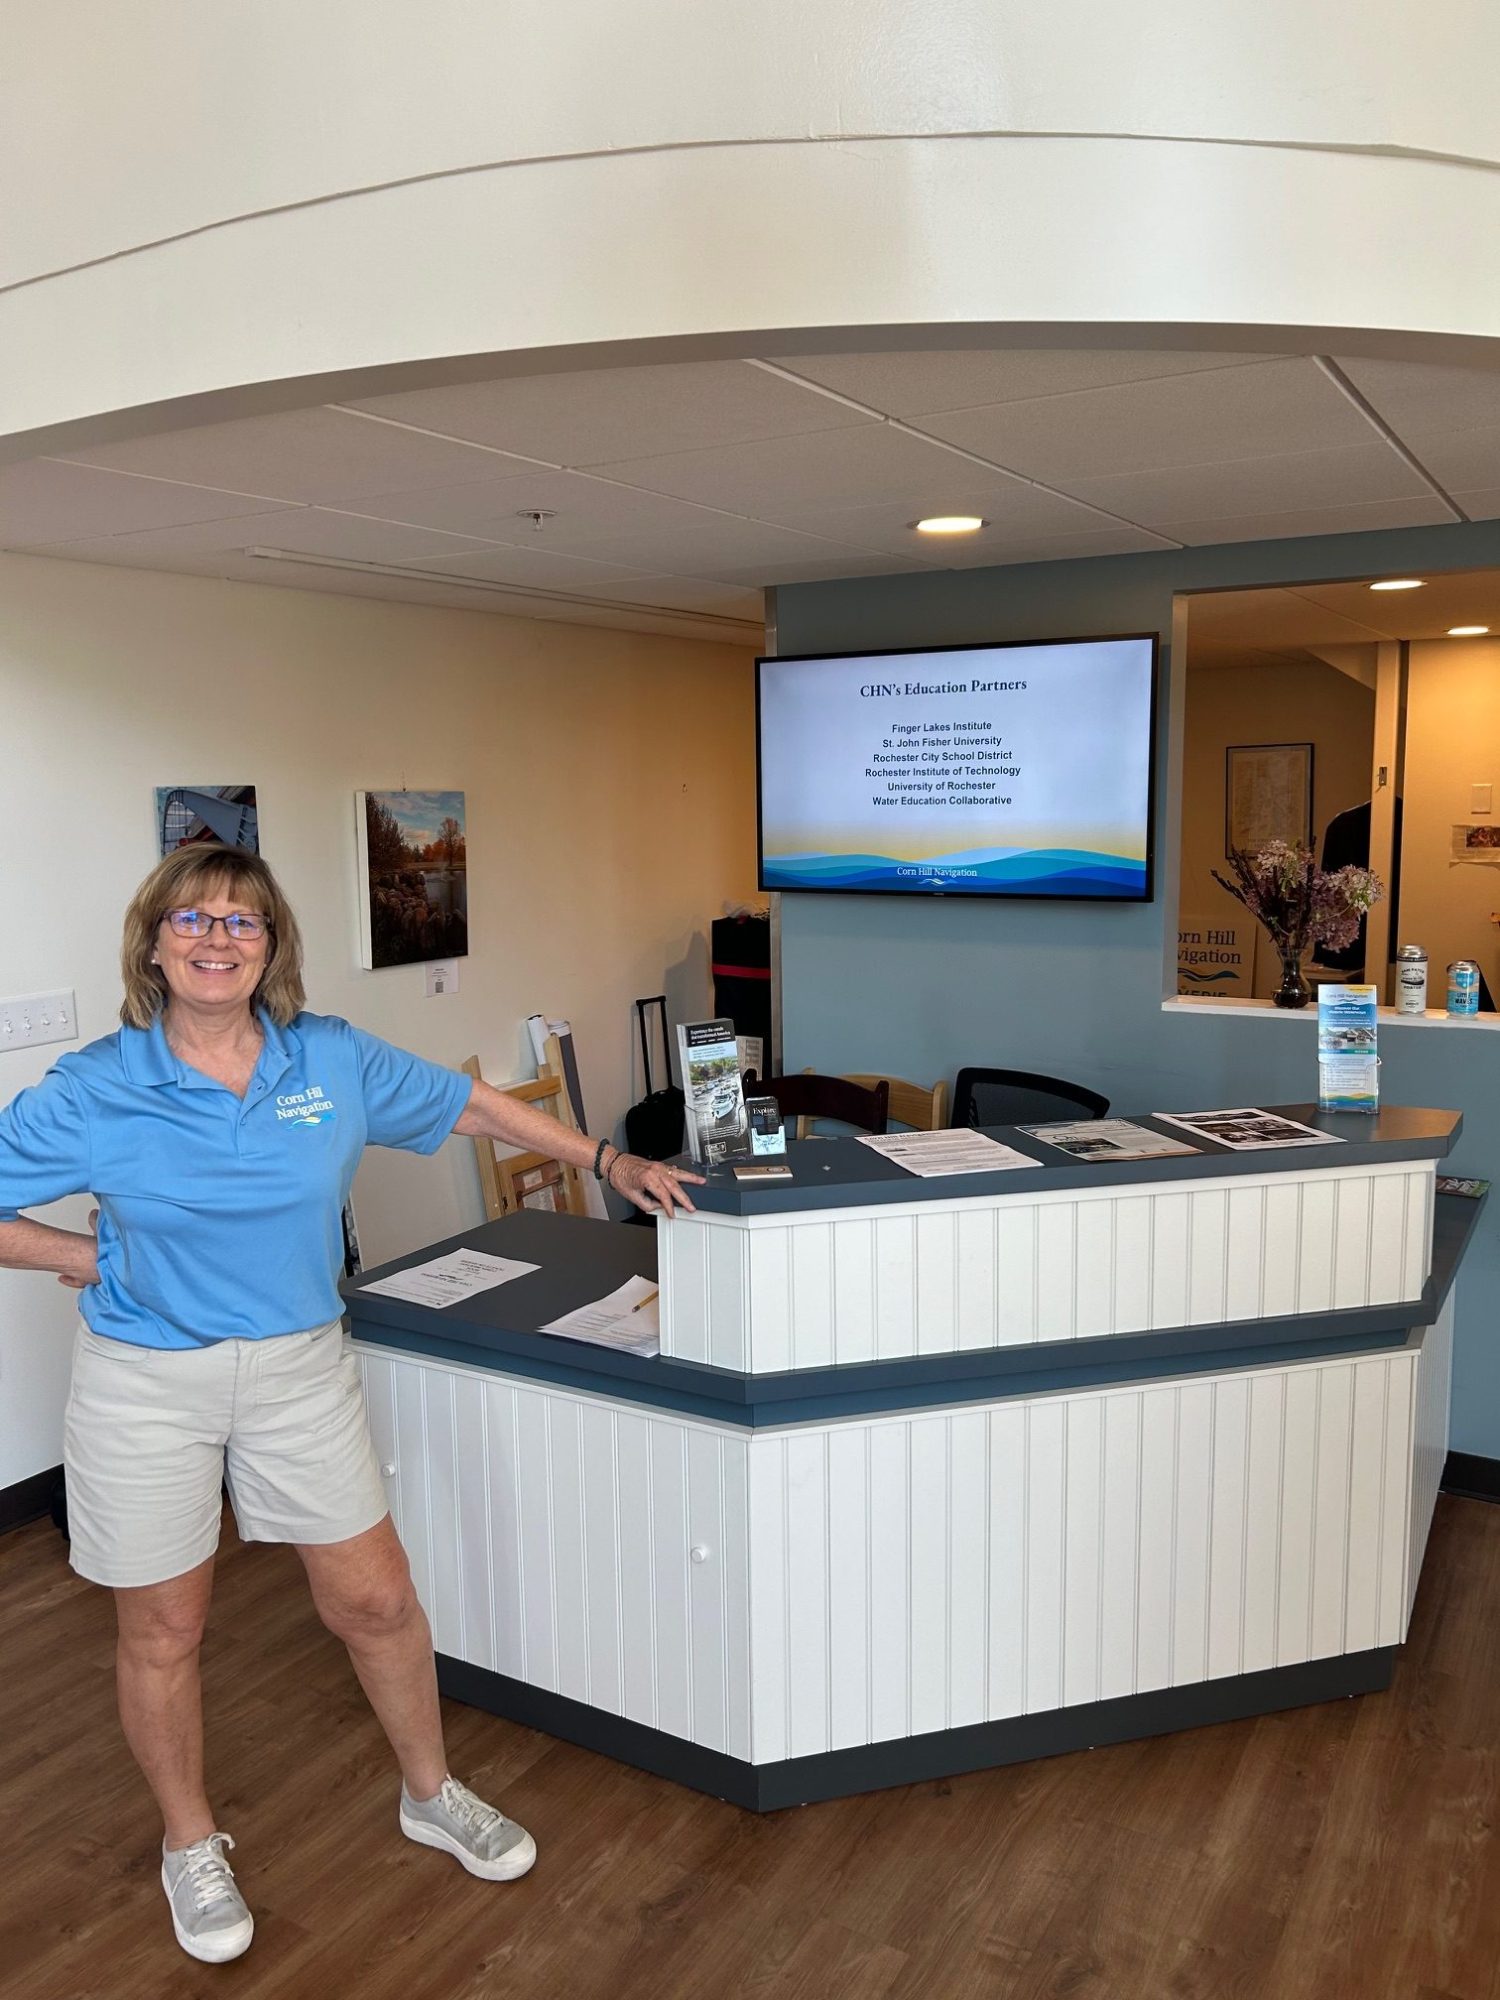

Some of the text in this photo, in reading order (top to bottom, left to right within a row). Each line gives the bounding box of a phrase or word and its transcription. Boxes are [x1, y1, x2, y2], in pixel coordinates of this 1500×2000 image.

[860, 679, 1028, 698] CHN's Education Partners
[892, 721, 992, 735] Finger Lakes Institute
[882, 736, 1002, 748] St. John Fisher University
[873, 750, 1013, 763] Rochester City School District
[865, 765, 1021, 777] Rochester Institute of Technology
[887, 781, 996, 793] University of Rochester
[872, 795, 1012, 806] Water Education Collaborative
[897, 867, 978, 878] Corn Hill Navigation
[1206, 930, 1236, 946] Hill
[1177, 947, 1242, 965] vigation
[274, 1100, 335, 1120] Navigation
[752, 1106, 777, 1116] Explore
